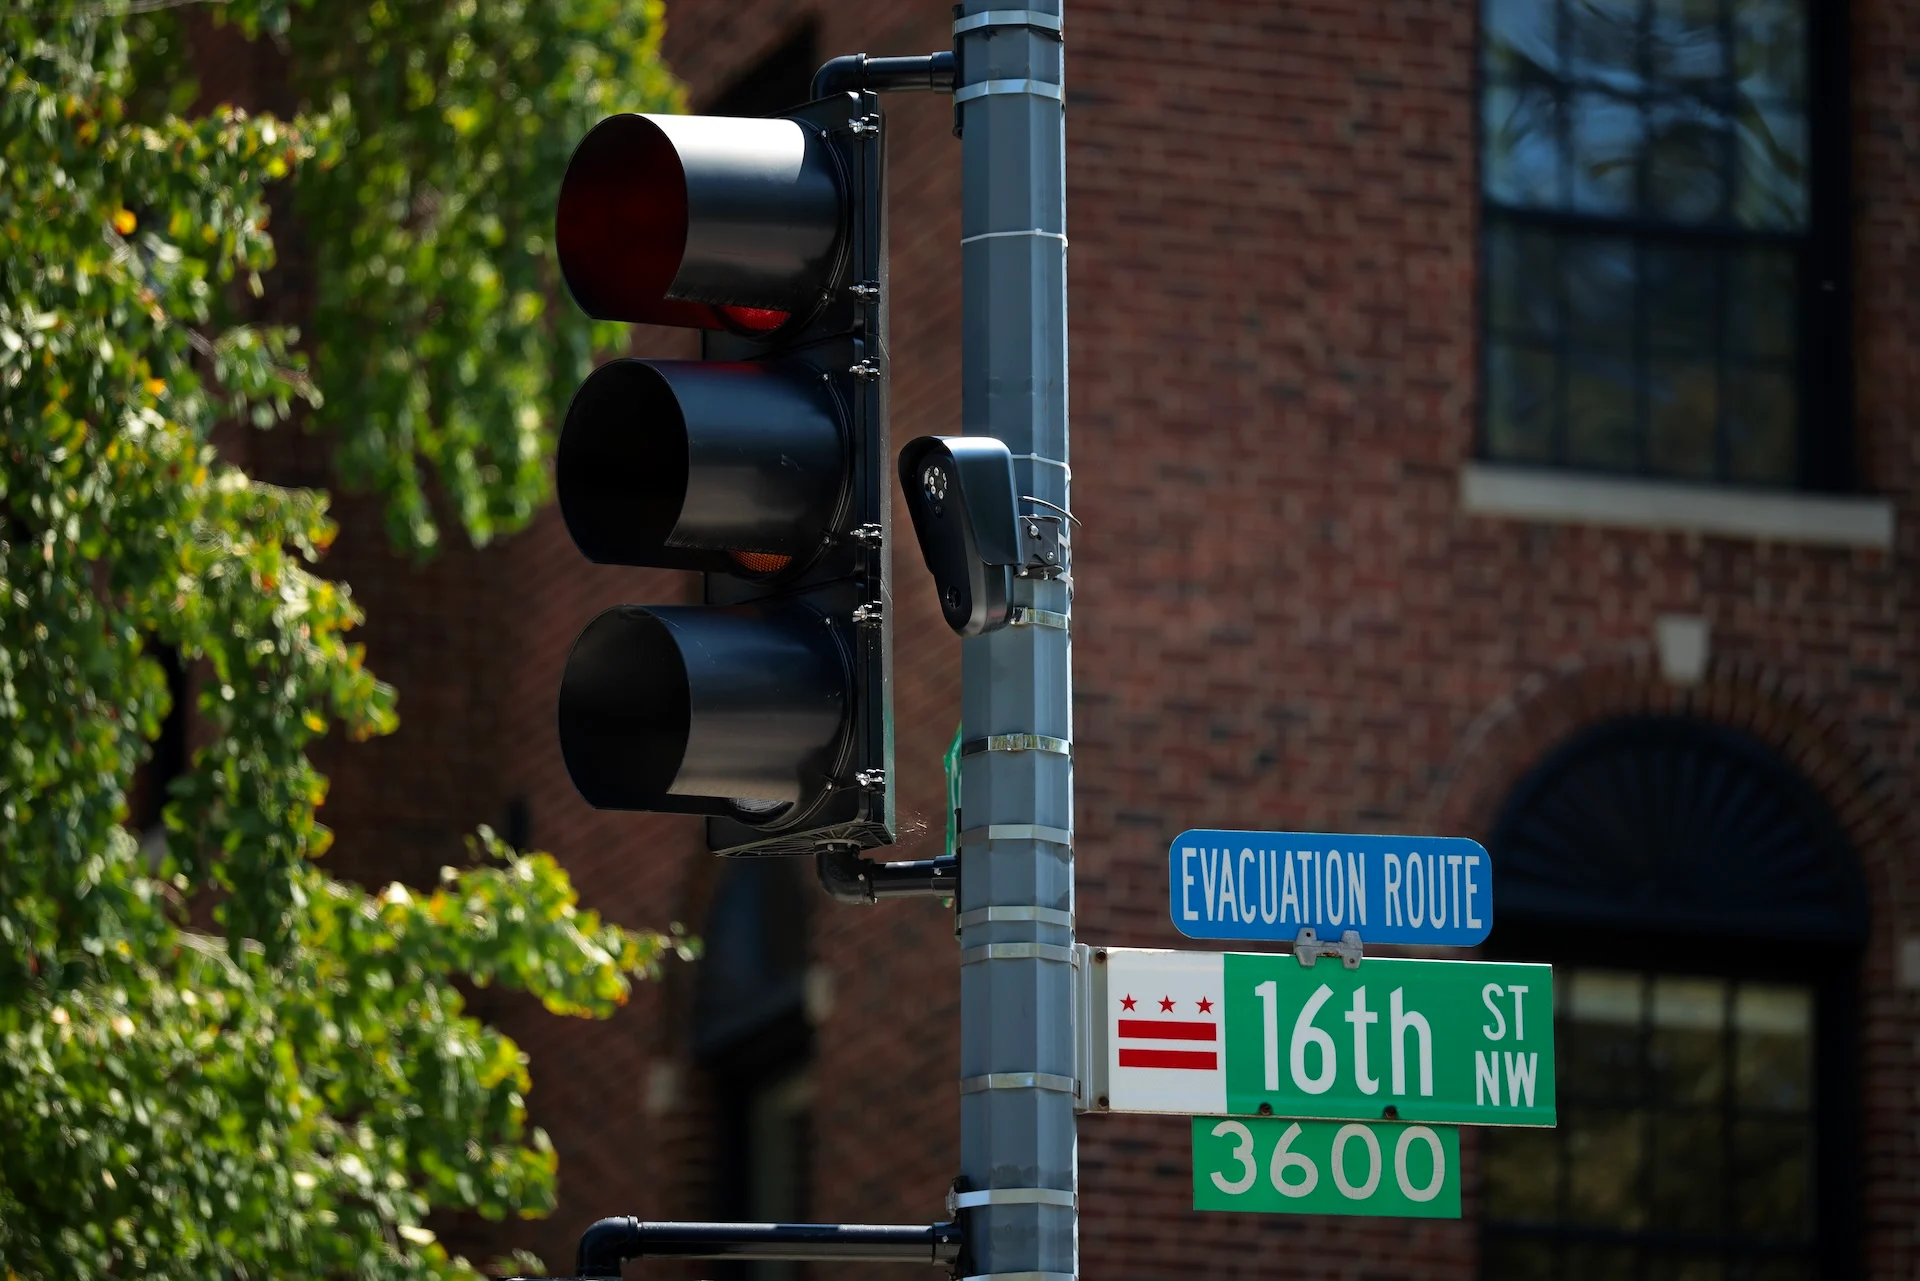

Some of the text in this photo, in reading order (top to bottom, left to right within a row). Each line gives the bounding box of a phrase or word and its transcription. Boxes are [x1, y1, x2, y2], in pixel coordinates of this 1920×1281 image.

[1181, 847, 1482, 928] EVACUATION ROUTE
[1254, 980, 1433, 1096] 16th
[1481, 982, 1529, 1040] ST
[1474, 1050, 1538, 1106] NW
[1209, 1119, 1445, 1201] 3600
